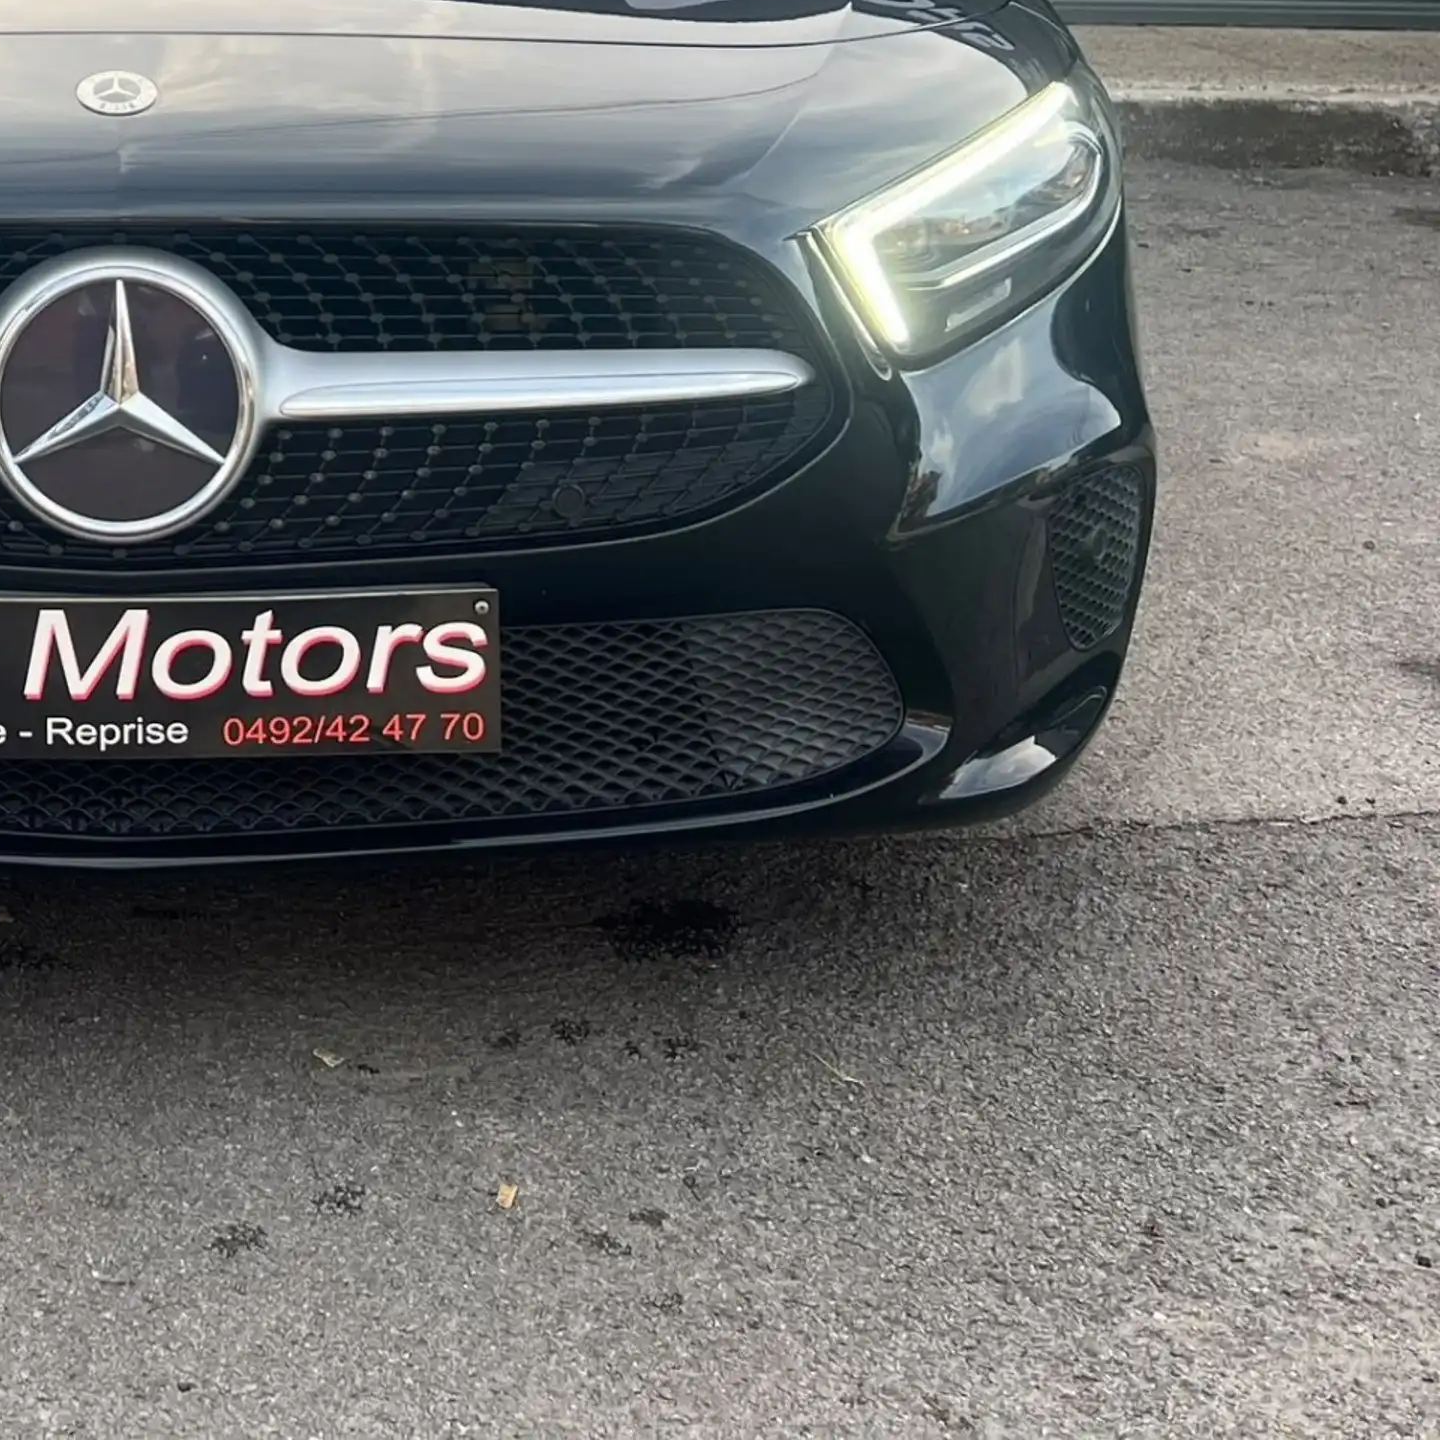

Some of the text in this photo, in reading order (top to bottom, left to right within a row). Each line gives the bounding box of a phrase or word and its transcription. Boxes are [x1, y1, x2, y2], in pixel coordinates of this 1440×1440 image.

[23, 608, 488, 700] Motors
[45, 717, 189, 752] Reprise
[223, 715, 370, 746] 0492/42
[381, 713, 427, 741] 47
[440, 711, 485, 741] 70
